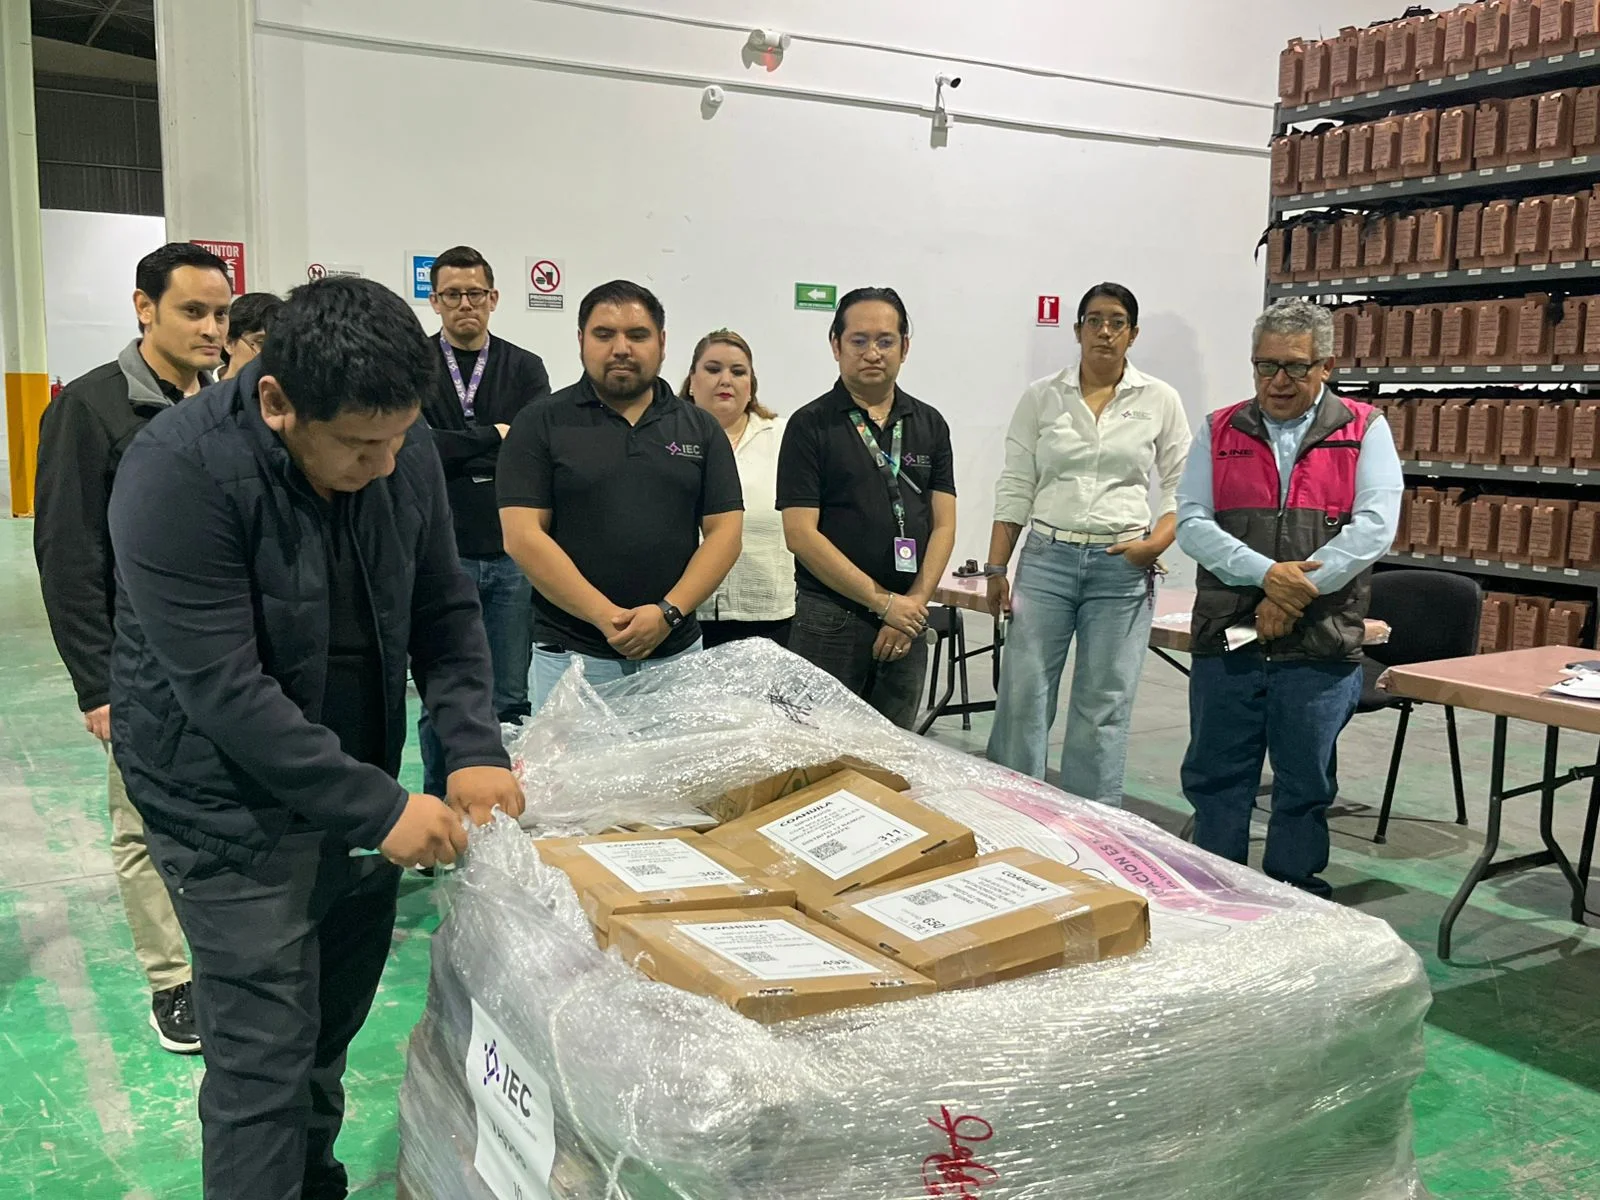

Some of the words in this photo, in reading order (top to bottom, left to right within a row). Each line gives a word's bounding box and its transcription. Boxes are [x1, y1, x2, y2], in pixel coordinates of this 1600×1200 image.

[682, 444, 701, 455] IEC
[916, 455, 930, 464] IEC
[780, 801, 833, 827] COAHUILA
[878, 829, 901, 842] 311
[1002, 870, 1048, 892] COAHUILA
[923, 917, 946, 929] 650
[503, 1063, 532, 1118] IEC
